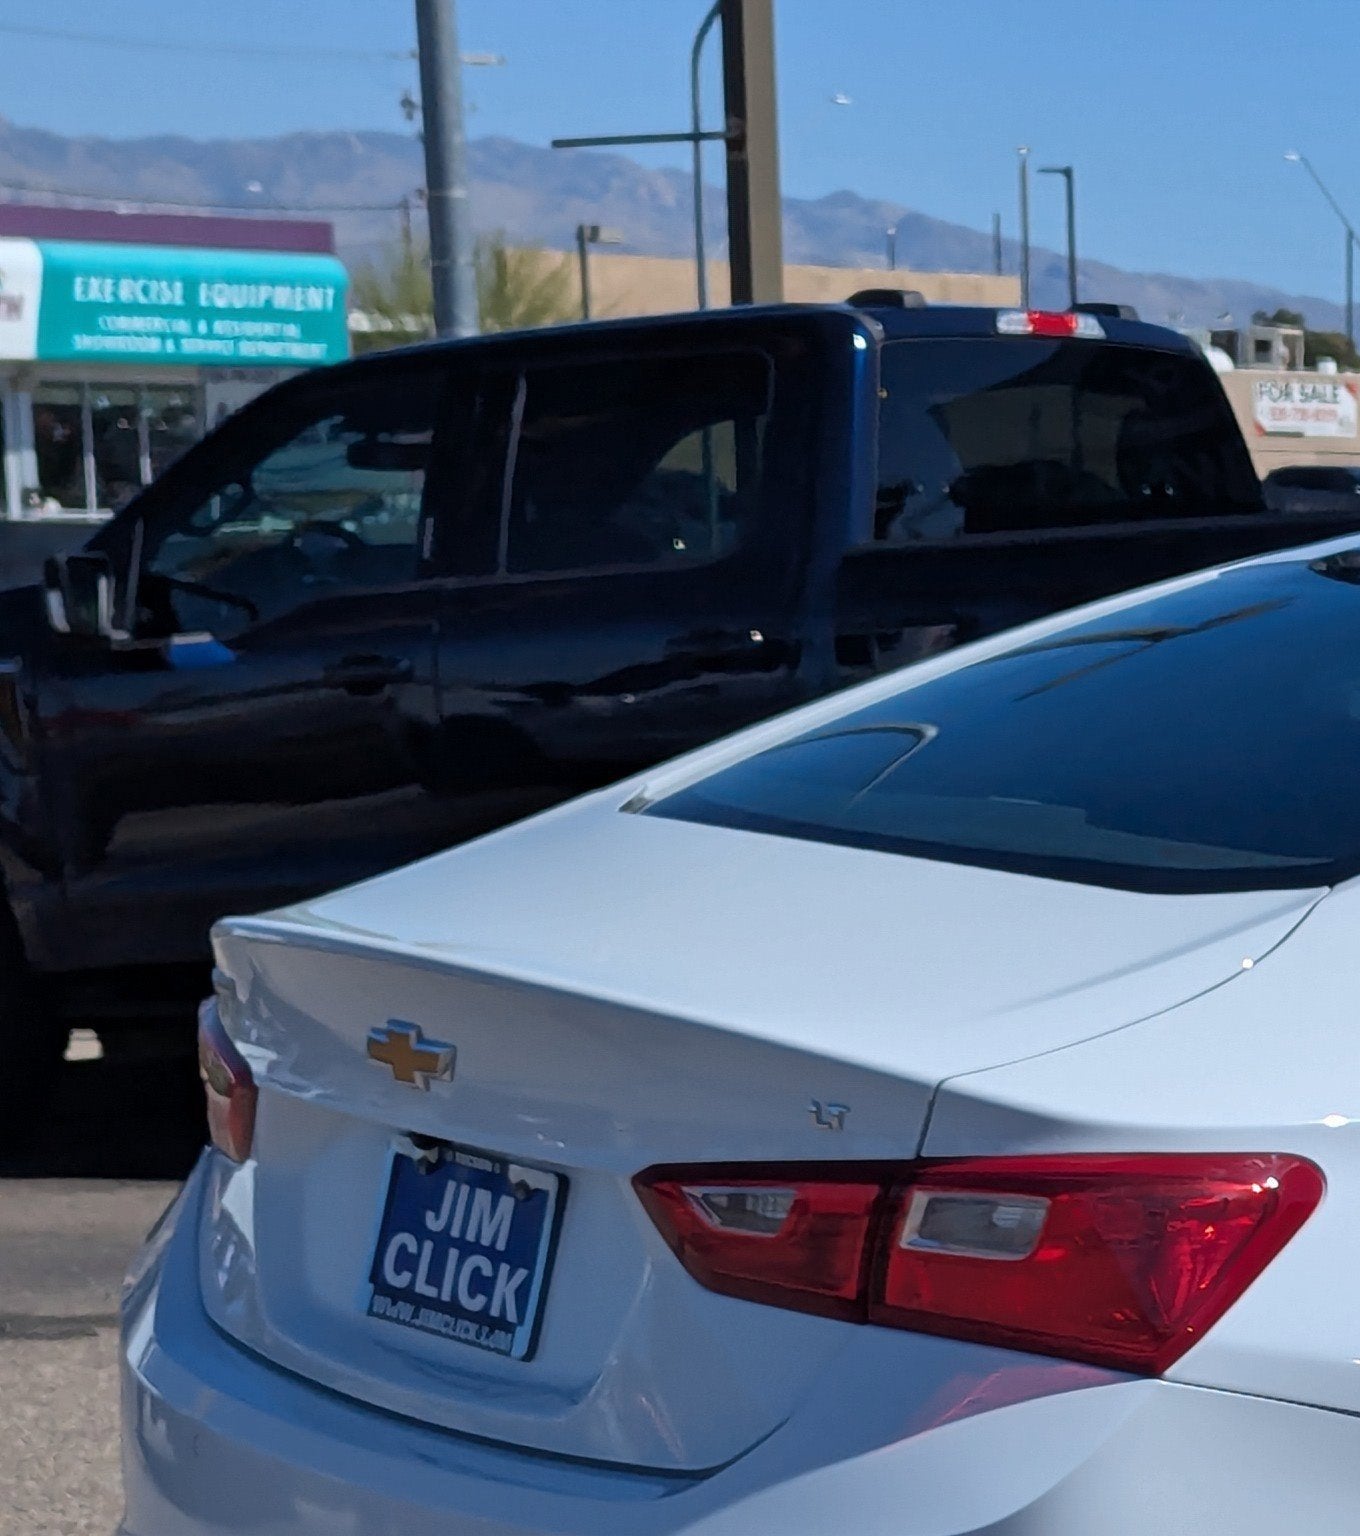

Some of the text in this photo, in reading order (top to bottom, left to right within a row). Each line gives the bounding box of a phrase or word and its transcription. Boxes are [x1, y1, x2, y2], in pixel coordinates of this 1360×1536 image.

[76, 277, 334, 310] EXERCISE EQUIPMENT
[1259, 381, 1340, 404] FOR SALE
[808, 1099, 851, 1131] LT
[425, 1179, 516, 1251] JIM
[383, 1232, 529, 1324] CLICK
